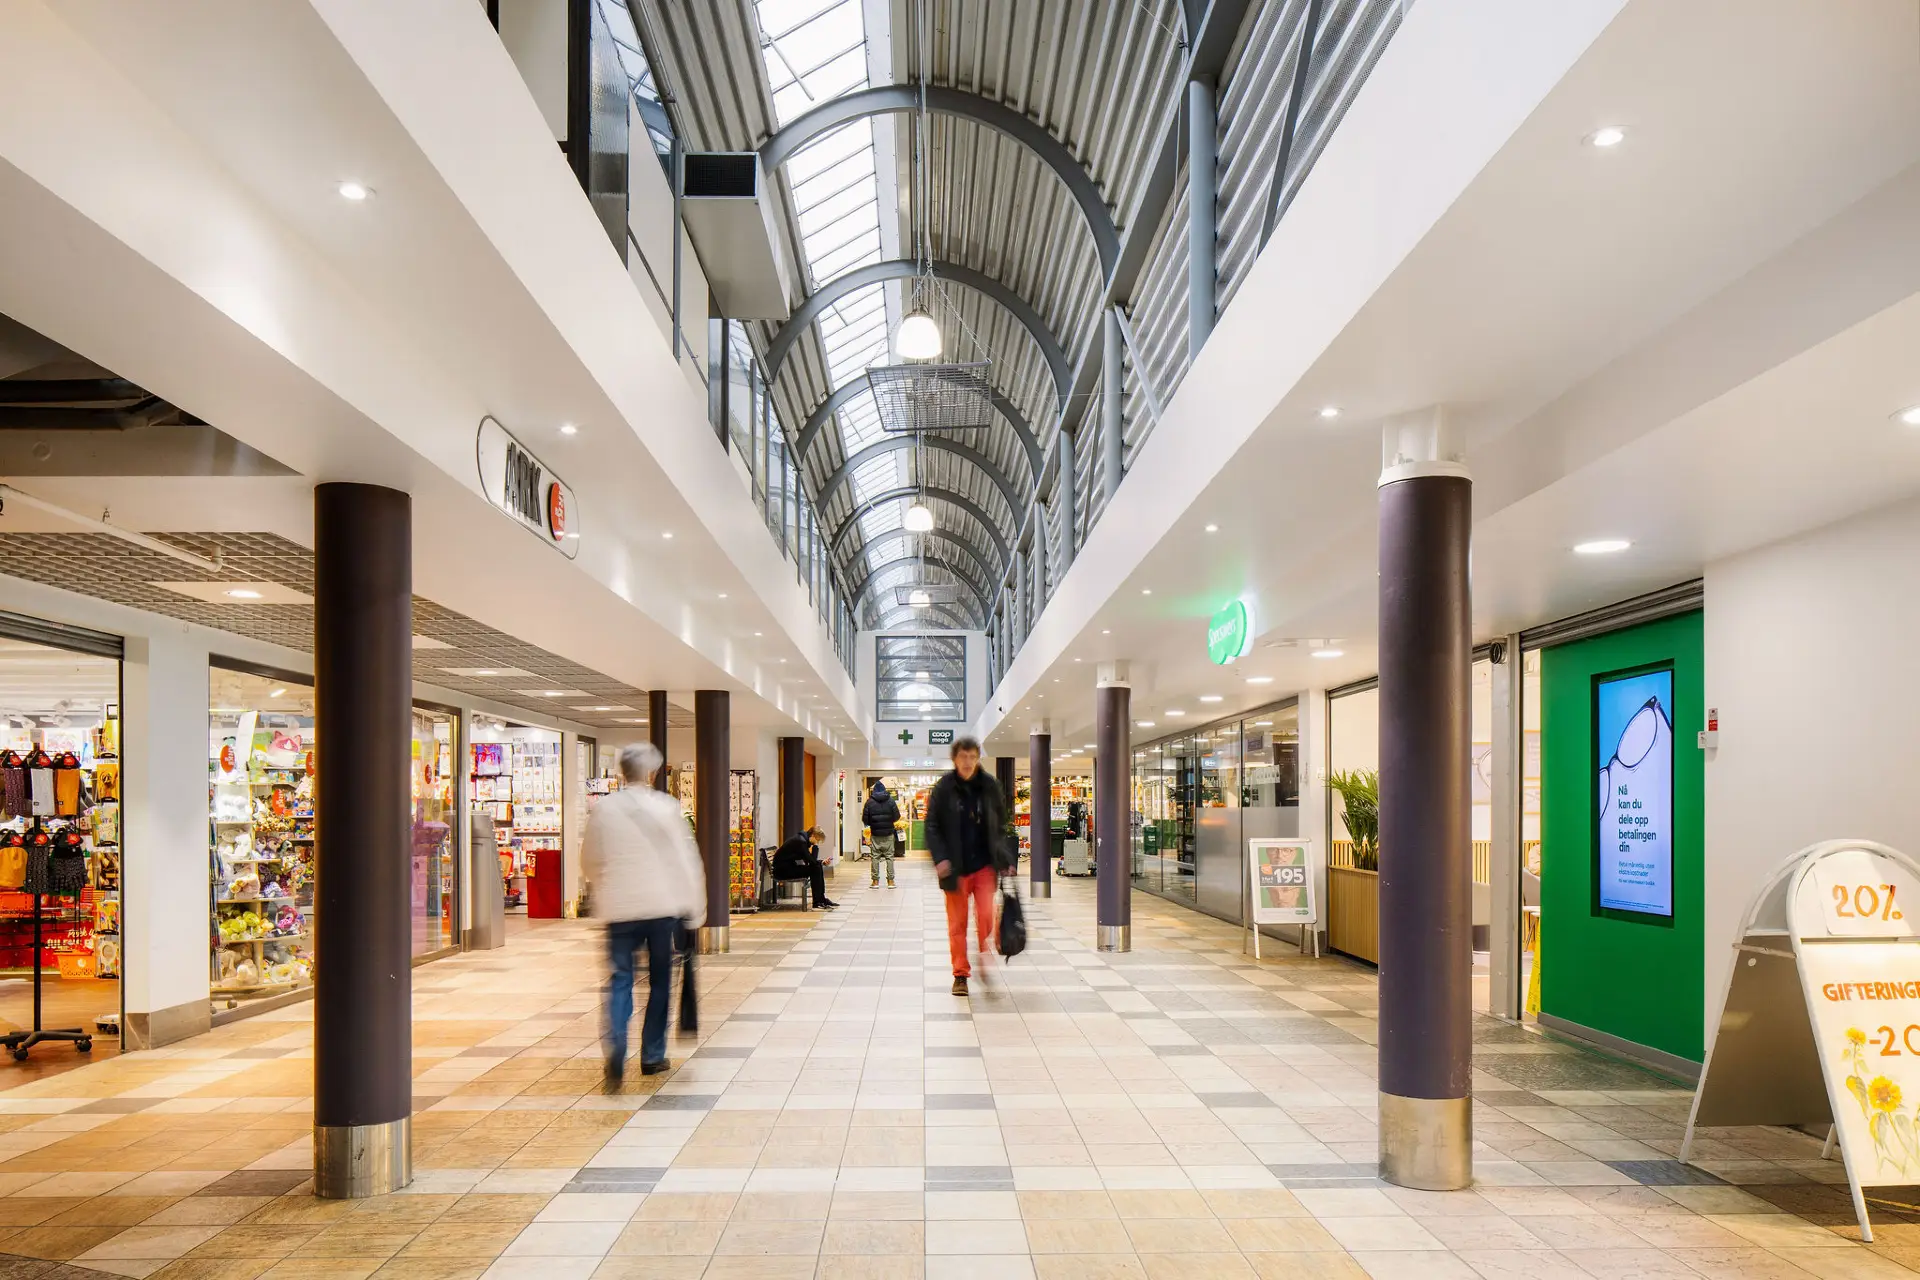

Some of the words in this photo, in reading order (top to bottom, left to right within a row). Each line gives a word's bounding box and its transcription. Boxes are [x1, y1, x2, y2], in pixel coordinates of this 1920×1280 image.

[504, 441, 543, 528] ARK
[931, 731, 951, 739] coop
[1618, 784, 1628, 796] Nå
[1618, 798, 1631, 809] kan
[1632, 798, 1642, 809] du
[1618, 814, 1633, 824] dele
[1634, 816, 1649, 827] opp
[1618, 828, 1657, 843] betalingen
[1618, 841, 1630, 852] din
[1274, 868, 1304, 884] 195
[1832, 884, 1904, 922] 20%
